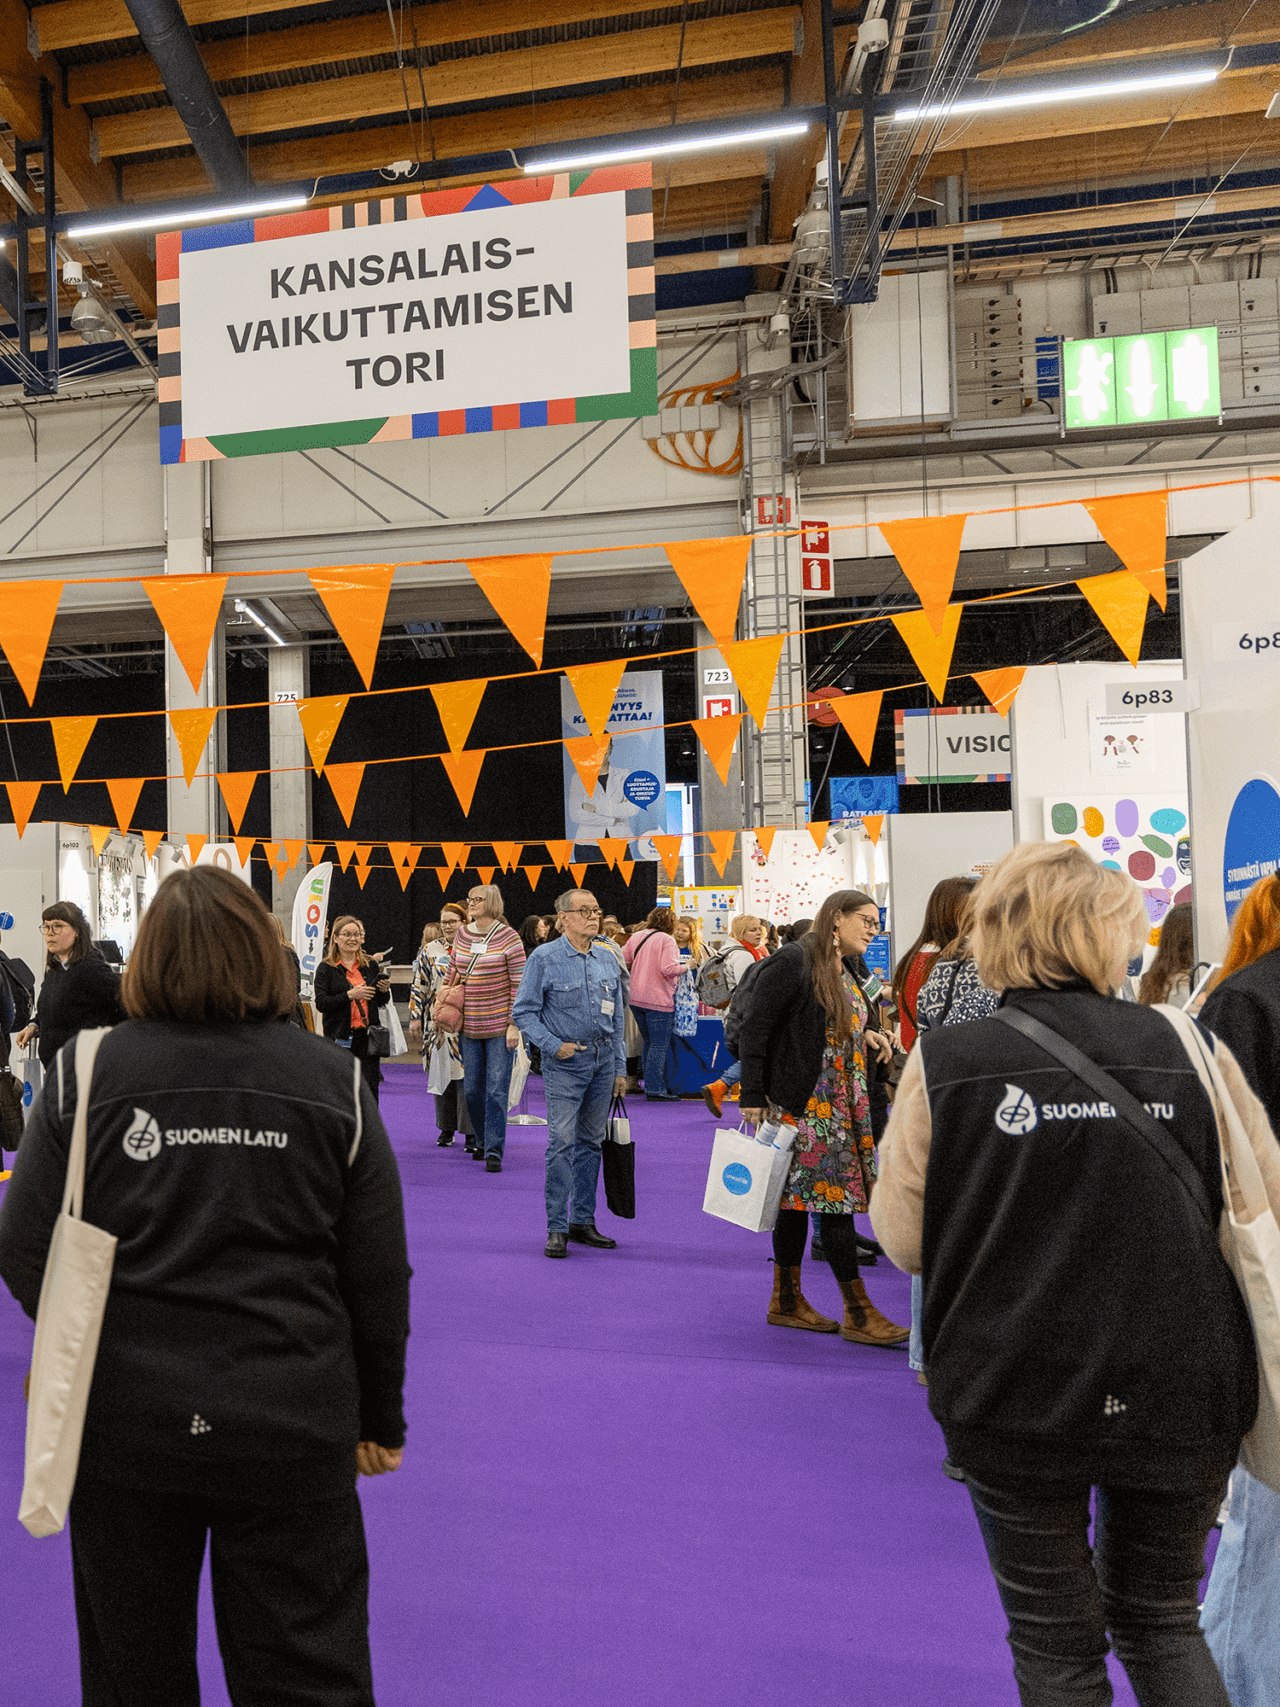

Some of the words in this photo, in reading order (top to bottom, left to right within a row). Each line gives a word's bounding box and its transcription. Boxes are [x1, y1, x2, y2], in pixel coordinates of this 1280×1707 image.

[269, 236, 536, 299] KANSALAIS-
[225, 281, 574, 354] VAIKUTTAMISEN
[345, 349, 446, 390] TORI
[706, 671, 730, 682] 723
[276, 693, 297, 702] 725
[1121, 689, 1174, 708] 6p83
[164, 1127, 242, 1146] SUOMEN
[243, 1128, 289, 1149] LATU
